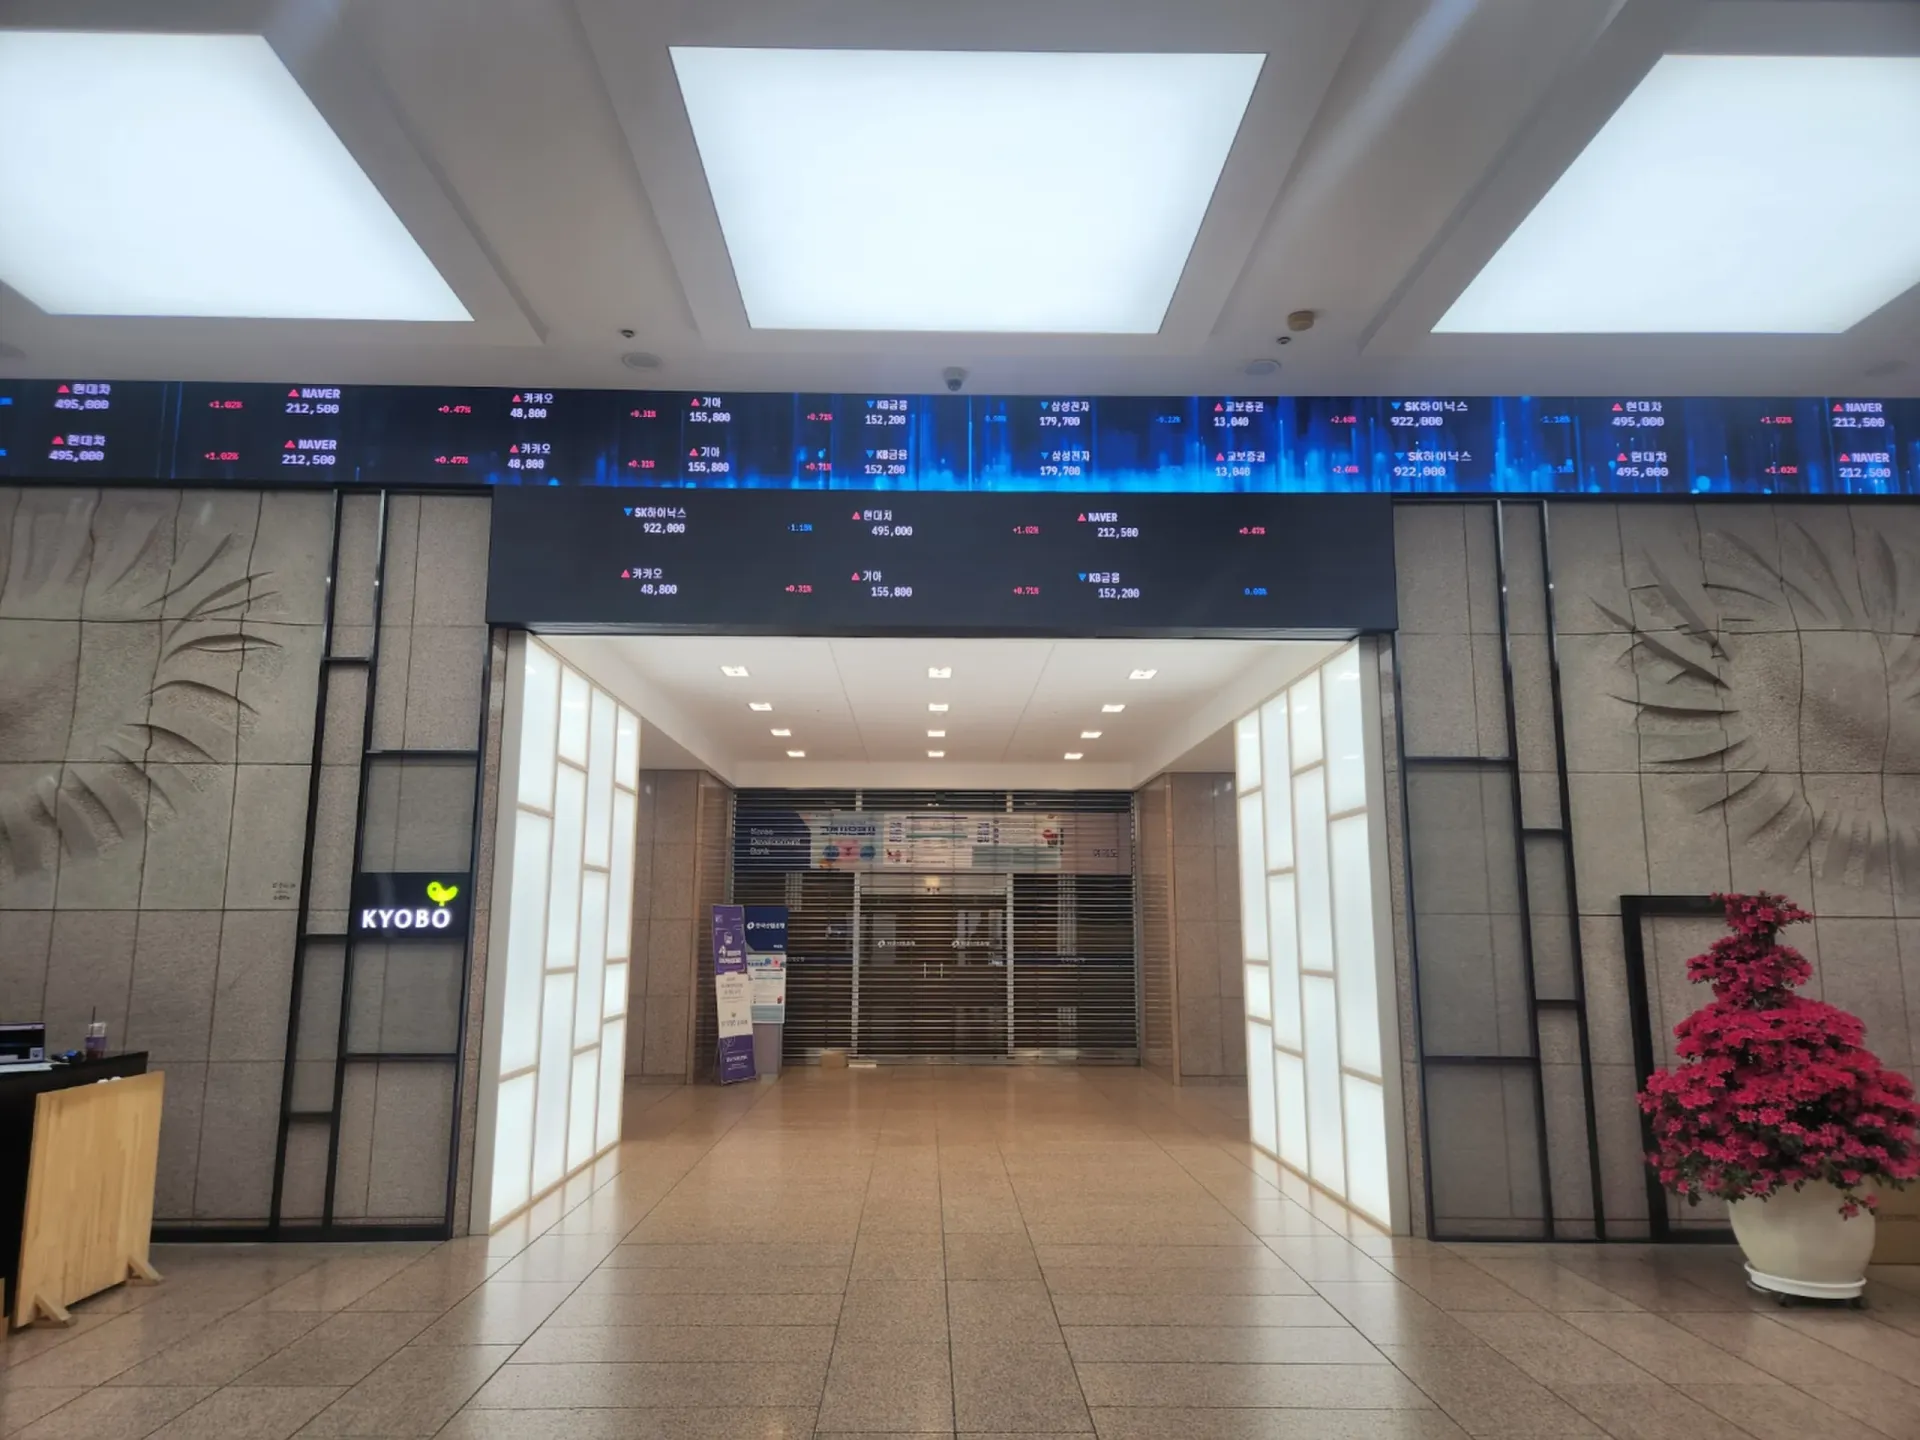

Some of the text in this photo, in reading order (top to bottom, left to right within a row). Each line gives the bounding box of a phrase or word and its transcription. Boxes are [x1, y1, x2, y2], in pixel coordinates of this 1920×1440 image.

[73, 384, 110, 394] 현대차
[302, 389, 340, 398] NAVER
[524, 393, 553, 403] 카카오
[703, 397, 721, 407] 기아
[55, 399, 109, 410] 495,000
[286, 403, 339, 414] 212,500
[877, 400, 907, 411] KB금융
[1052, 402, 1089, 412] 삼성전자
[1226, 402, 1263, 412] 교보증권
[1405, 402, 1467, 411] SK하이닉스
[1626, 402, 1662, 412] 현대차
[1846, 403, 1882, 412] NAVER
[510, 408, 546, 419] 48,800
[690, 412, 730, 422] 155,800
[866, 415, 905, 425] 152,200
[1040, 417, 1080, 427] 179,700
[1391, 417, 1443, 427] 922,000
[1612, 417, 1664, 427] 495,000
[1834, 417, 1885, 428] 212,500
[68, 435, 105, 446] 현대차
[298, 440, 337, 449] NAVER
[521, 444, 550, 454] 카카오
[701, 447, 720, 457] 기아
[49, 450, 104, 462] 495,000
[282, 455, 335, 465] 212,500
[876, 450, 907, 460] KB금융
[1052, 451, 1090, 461] 삼성전자
[1228, 451, 1265, 462] 교보증권
[1408, 451, 1471, 461] SK하이닉스
[1631, 451, 1667, 462] 현대차
[1851, 453, 1889, 462] NAVER
[508, 459, 544, 469] 48,800
[688, 462, 729, 472] 155,800
[865, 465, 905, 474] 152,200
[1040, 466, 1080, 475] 179,700
[1394, 466, 1446, 477] 922,000
[1617, 467, 1668, 477] 495,000
[1839, 468, 1891, 478] 212,500
[635, 507, 686, 518] SK하이닉스
[864, 510, 892, 521] 현대차
[1088, 513, 1117, 522] NAVER
[644, 523, 685, 533] 922,000
[872, 526, 912, 536] 495,000
[1098, 528, 1138, 538] 212,500
[633, 568, 662, 579] 카카오
[863, 571, 881, 581] 기아
[1089, 573, 1119, 583] KB금융
[641, 584, 677, 595] 48,800
[872, 587, 912, 597] 155,800
[1098, 588, 1139, 598] 152,200
[362, 909, 450, 928] KYOBO
